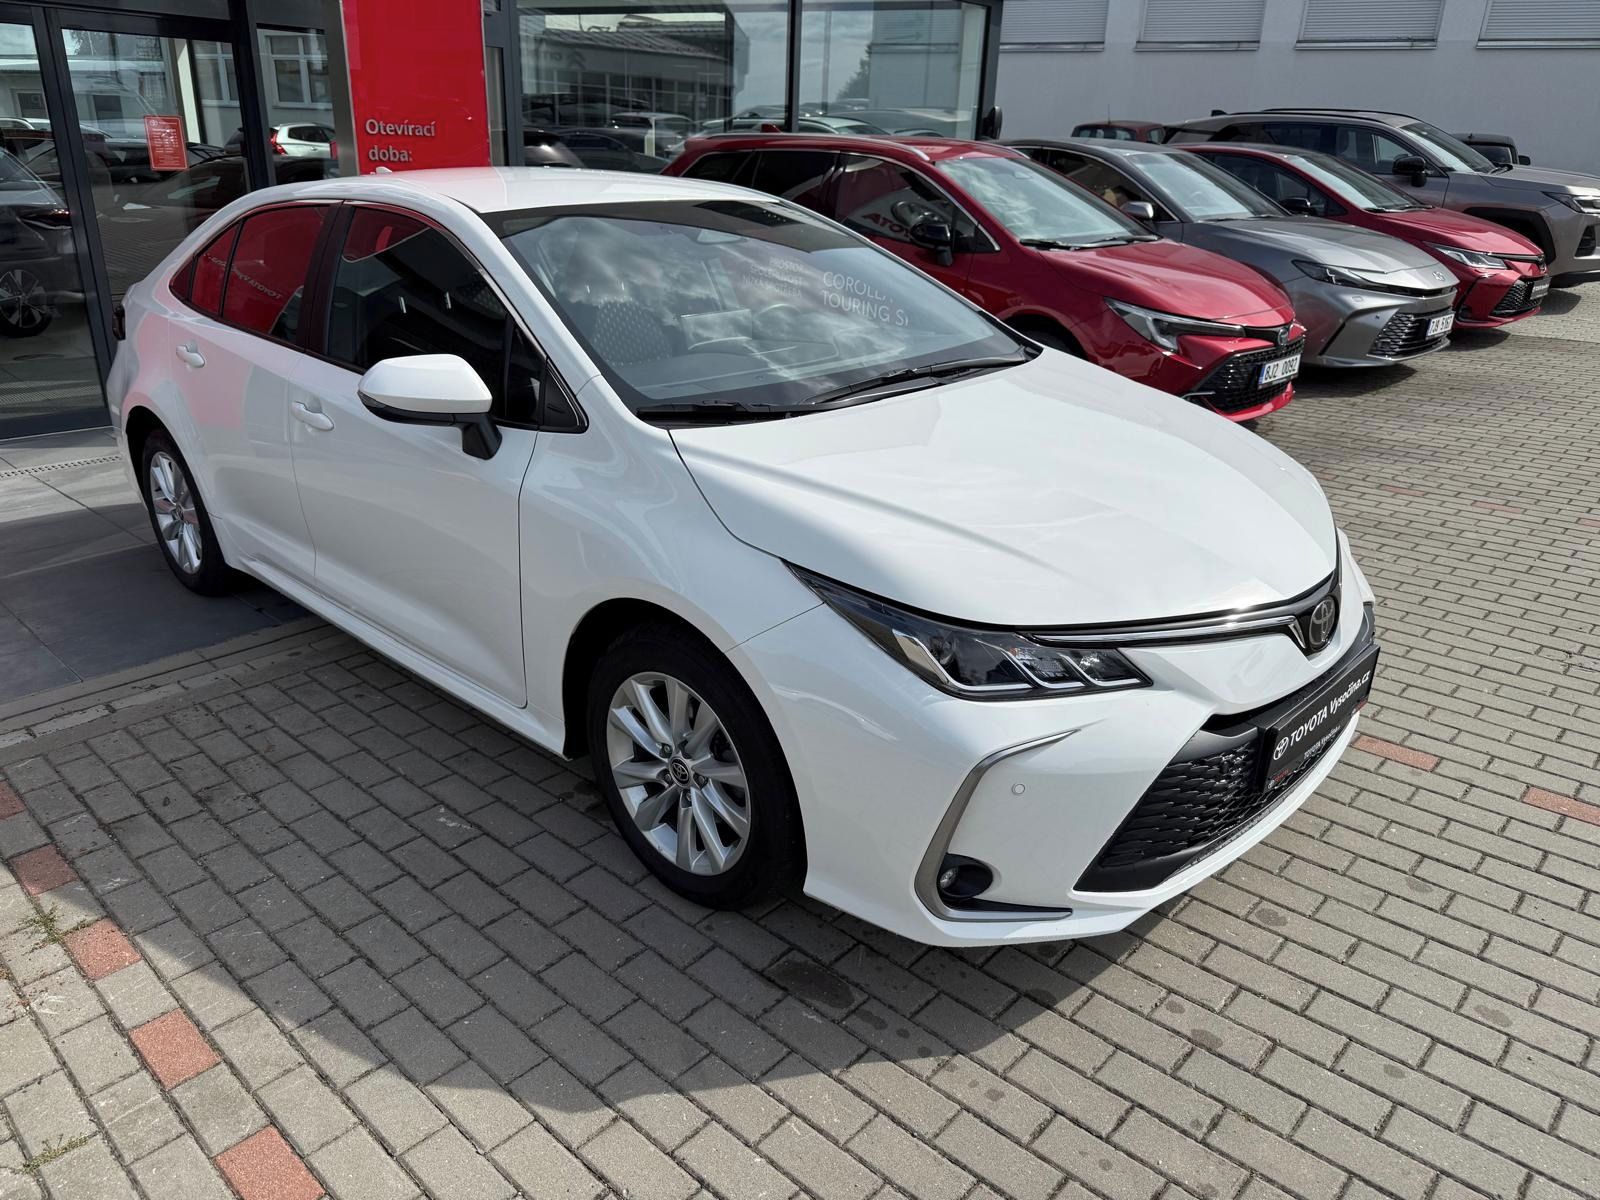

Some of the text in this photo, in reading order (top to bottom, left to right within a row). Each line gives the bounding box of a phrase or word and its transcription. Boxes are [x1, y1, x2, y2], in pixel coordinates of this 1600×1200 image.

[365, 119, 436, 136] Otevírací
[368, 145, 413, 161] doba:
[820, 289, 890, 323] TOURING
[1264, 363, 1279, 380] 8J2
[1290, 670, 1371, 746] TOYOTA Vysočina.cz
